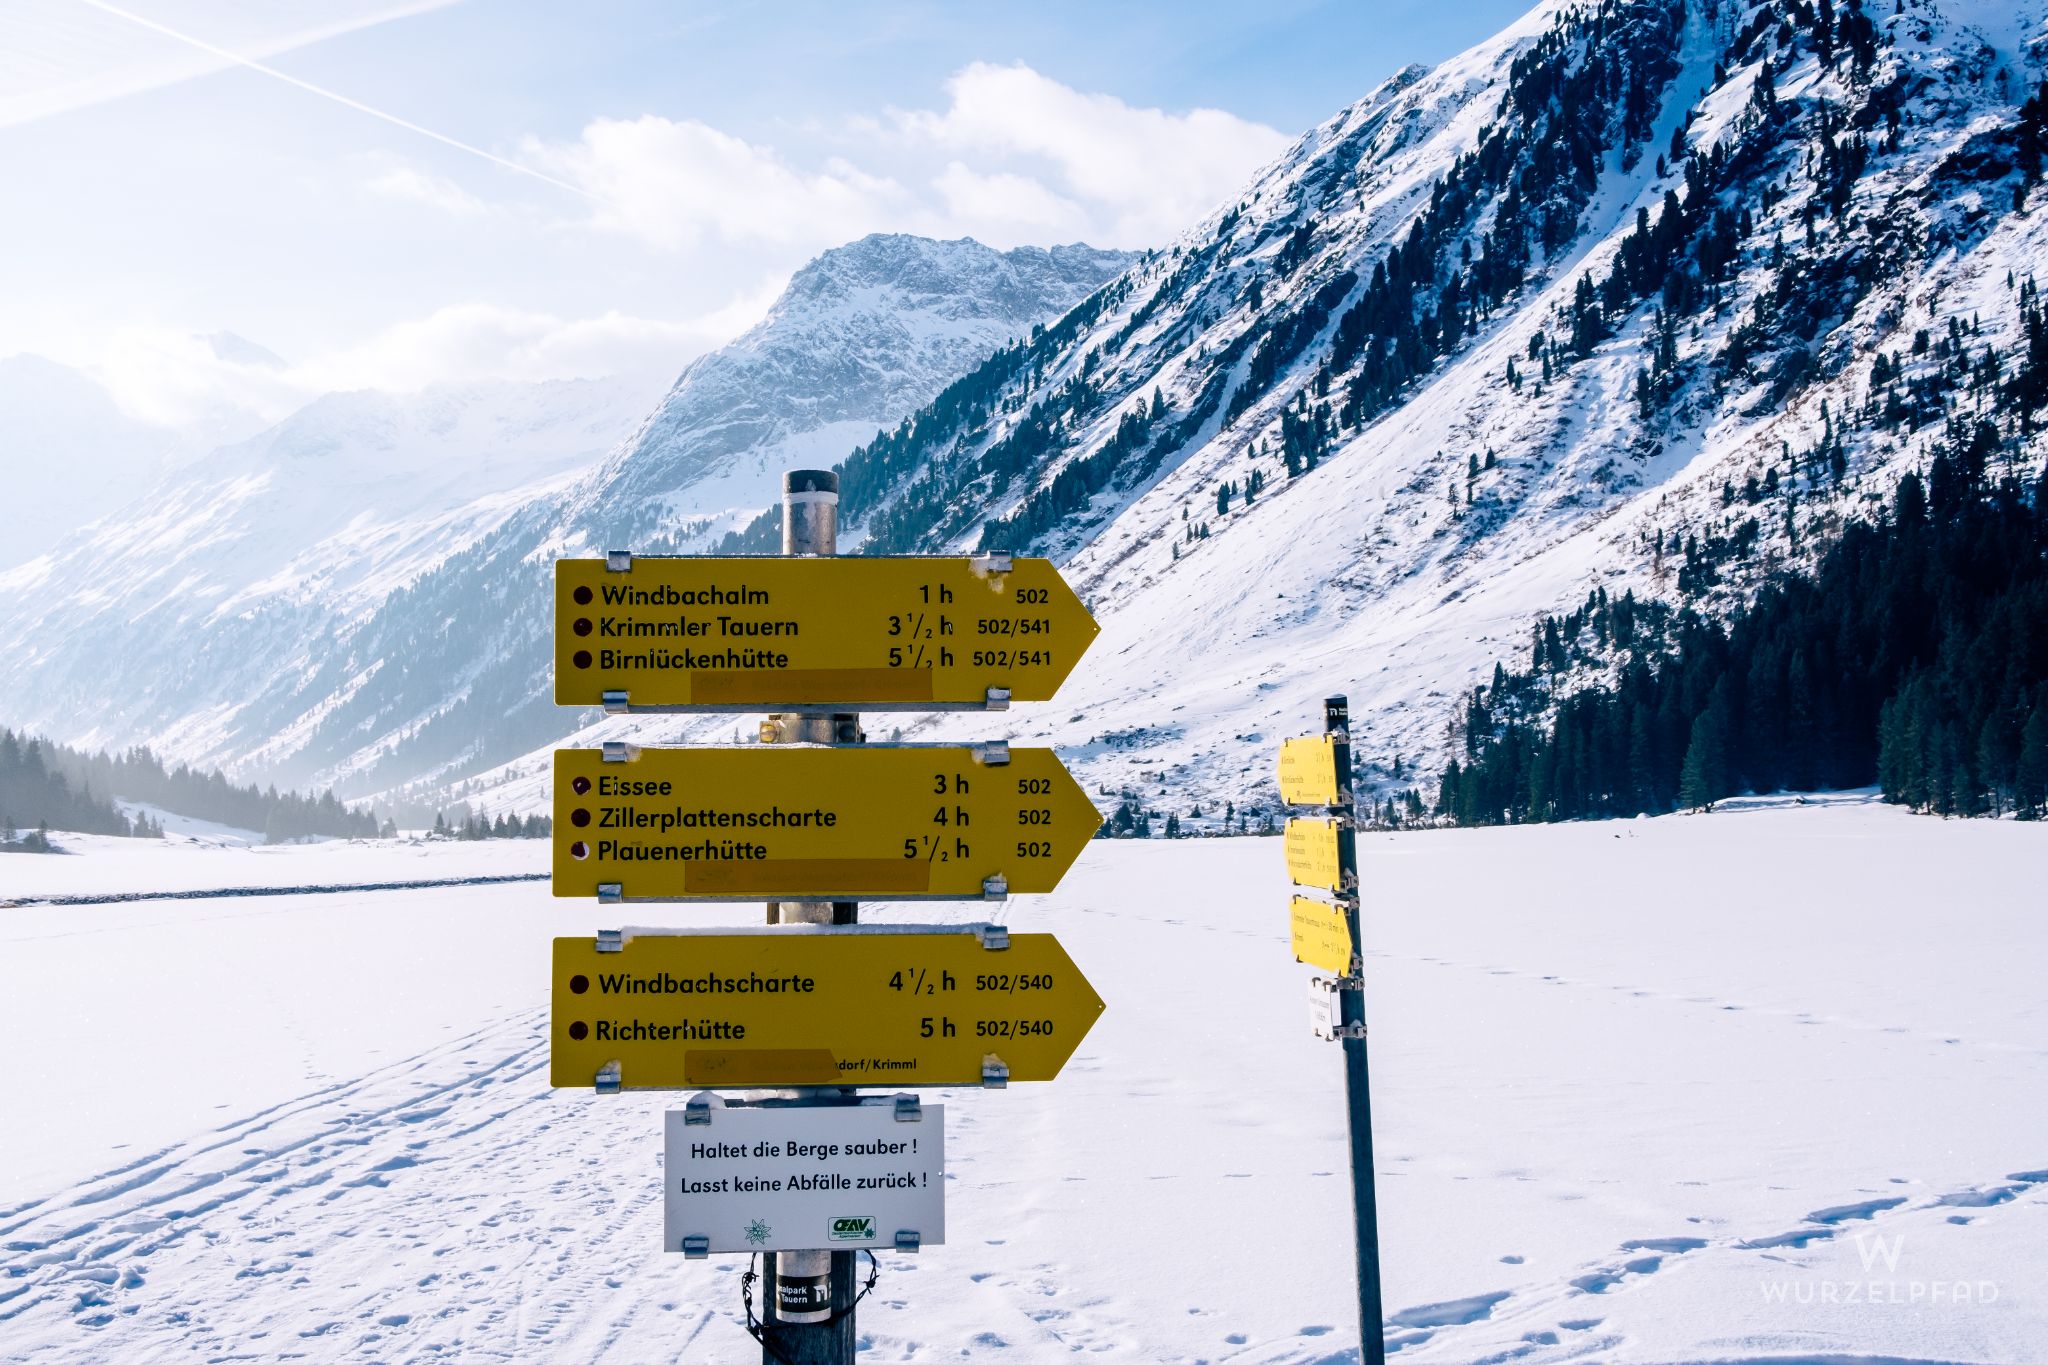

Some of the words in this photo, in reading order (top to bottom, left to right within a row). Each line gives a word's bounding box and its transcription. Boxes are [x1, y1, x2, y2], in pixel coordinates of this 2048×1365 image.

[600, 584, 769, 606] Windbachalm
[919, 584, 929, 604] 1
[939, 583, 953, 604] h
[1016, 588, 1049, 605] 502
[600, 615, 712, 637] Krimmler
[716, 616, 799, 637] Tauern
[887, 615, 902, 636] 3
[940, 614, 954, 636] h
[977, 618, 1050, 639] 502/541
[600, 646, 789, 670] Birnlückenhütte
[888, 647, 903, 668] 5
[940, 646, 954, 667] h
[972, 650, 1051, 671] 502/541
[599, 775, 673, 797] Eissee
[933, 774, 947, 795] 3
[955, 773, 970, 795] h
[1017, 778, 1051, 795] 502
[599, 806, 837, 834] Zillerplattenscharte
[933, 806, 949, 827] 4
[956, 805, 970, 827] h
[1018, 809, 1052, 826] 502
[599, 838, 768, 862] Plauenerhütte
[903, 838, 918, 860] 5
[956, 837, 970, 859] h
[1016, 841, 1052, 858] 502
[599, 971, 815, 994] Windbachscharte
[888, 970, 904, 992] 4
[942, 969, 956, 991] h
[975, 974, 1053, 995] 502/540
[596, 1017, 746, 1041] Richterhütte
[919, 1017, 934, 1039] 5
[942, 1016, 956, 1038] h
[976, 1019, 1054, 1041] 502/540
[834, 1058, 917, 1073] dorf/Krimml
[691, 1142, 748, 1159] Haltet
[753, 1141, 780, 1158] die
[786, 1141, 839, 1161] Berge
[844, 1138, 908, 1156] sauber
[681, 1177, 729, 1194] Lasst
[734, 1175, 782, 1192] keine
[786, 1173, 851, 1191] Abfälle
[856, 1171, 917, 1189] zurück
